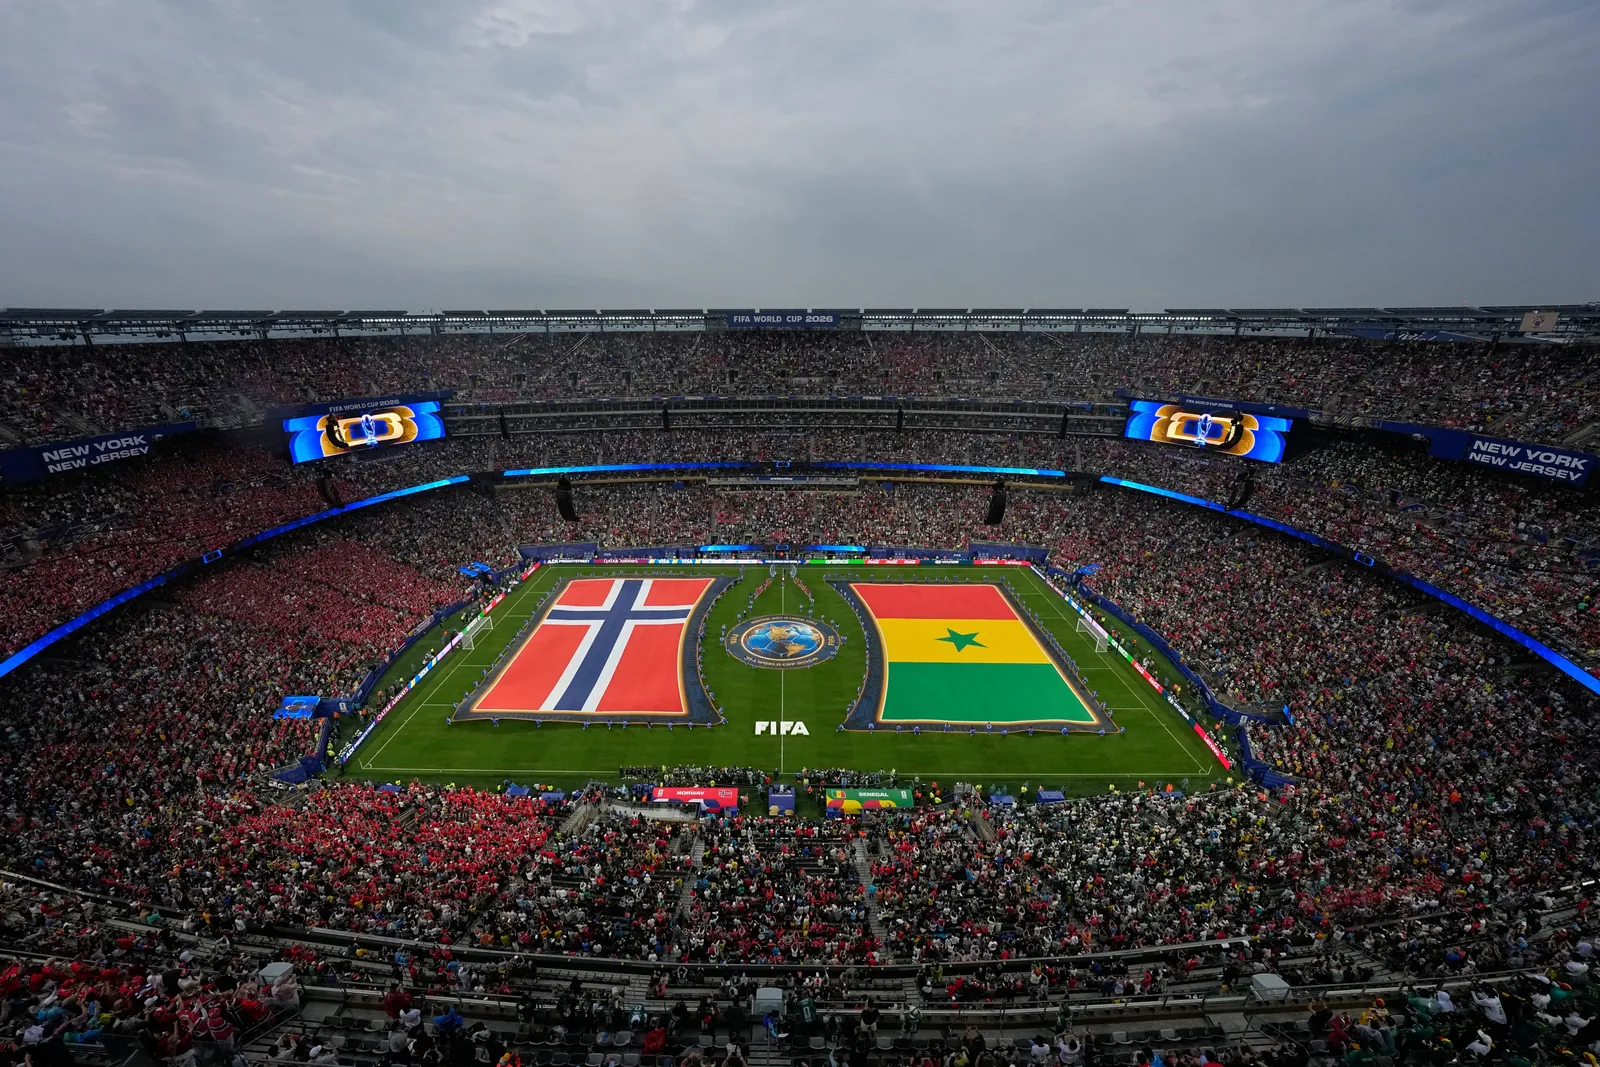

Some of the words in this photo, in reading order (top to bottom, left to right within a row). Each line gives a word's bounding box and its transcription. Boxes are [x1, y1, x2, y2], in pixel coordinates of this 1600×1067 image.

[733, 315, 750, 323] FIFA
[753, 315, 782, 323] WORLD
[786, 315, 802, 323] CUP
[805, 315, 834, 323] 2026
[42, 444, 90, 462] NEW
[93, 434, 148, 452] YORK
[48, 458, 86, 474] NEW
[90, 446, 149, 464] JERSEY
[1472, 440, 1521, 457] NEW
[1526, 449, 1588, 470] YORK
[1468, 452, 1508, 466] NEW
[1508, 462, 1582, 481] JERSEY
[755, 721, 810, 736] FIFA
[1204, 734, 1220, 756] Lenovo
